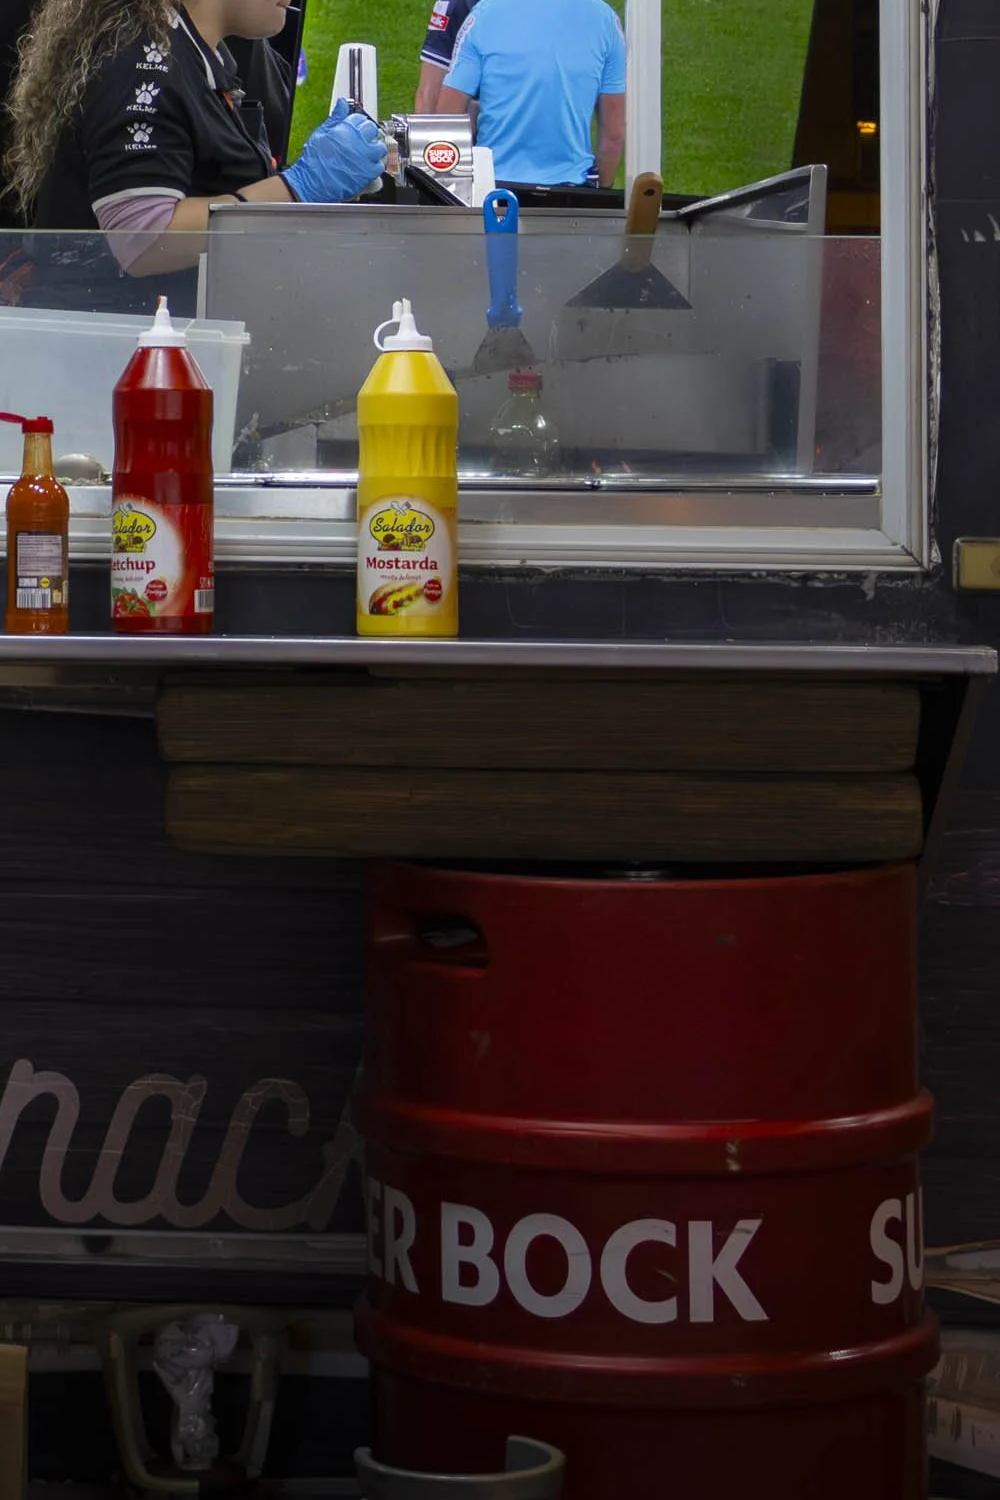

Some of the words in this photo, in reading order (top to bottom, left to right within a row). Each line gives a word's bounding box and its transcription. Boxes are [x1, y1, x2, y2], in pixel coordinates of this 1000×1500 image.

[135, 62, 169, 73] KELME
[126, 104, 158, 114] KELME
[430, 156, 453, 164] BOCK
[373, 516, 431, 533] Salador
[366, 556, 438, 570] Mostarda
[441, 1201, 770, 1324] BOCK
